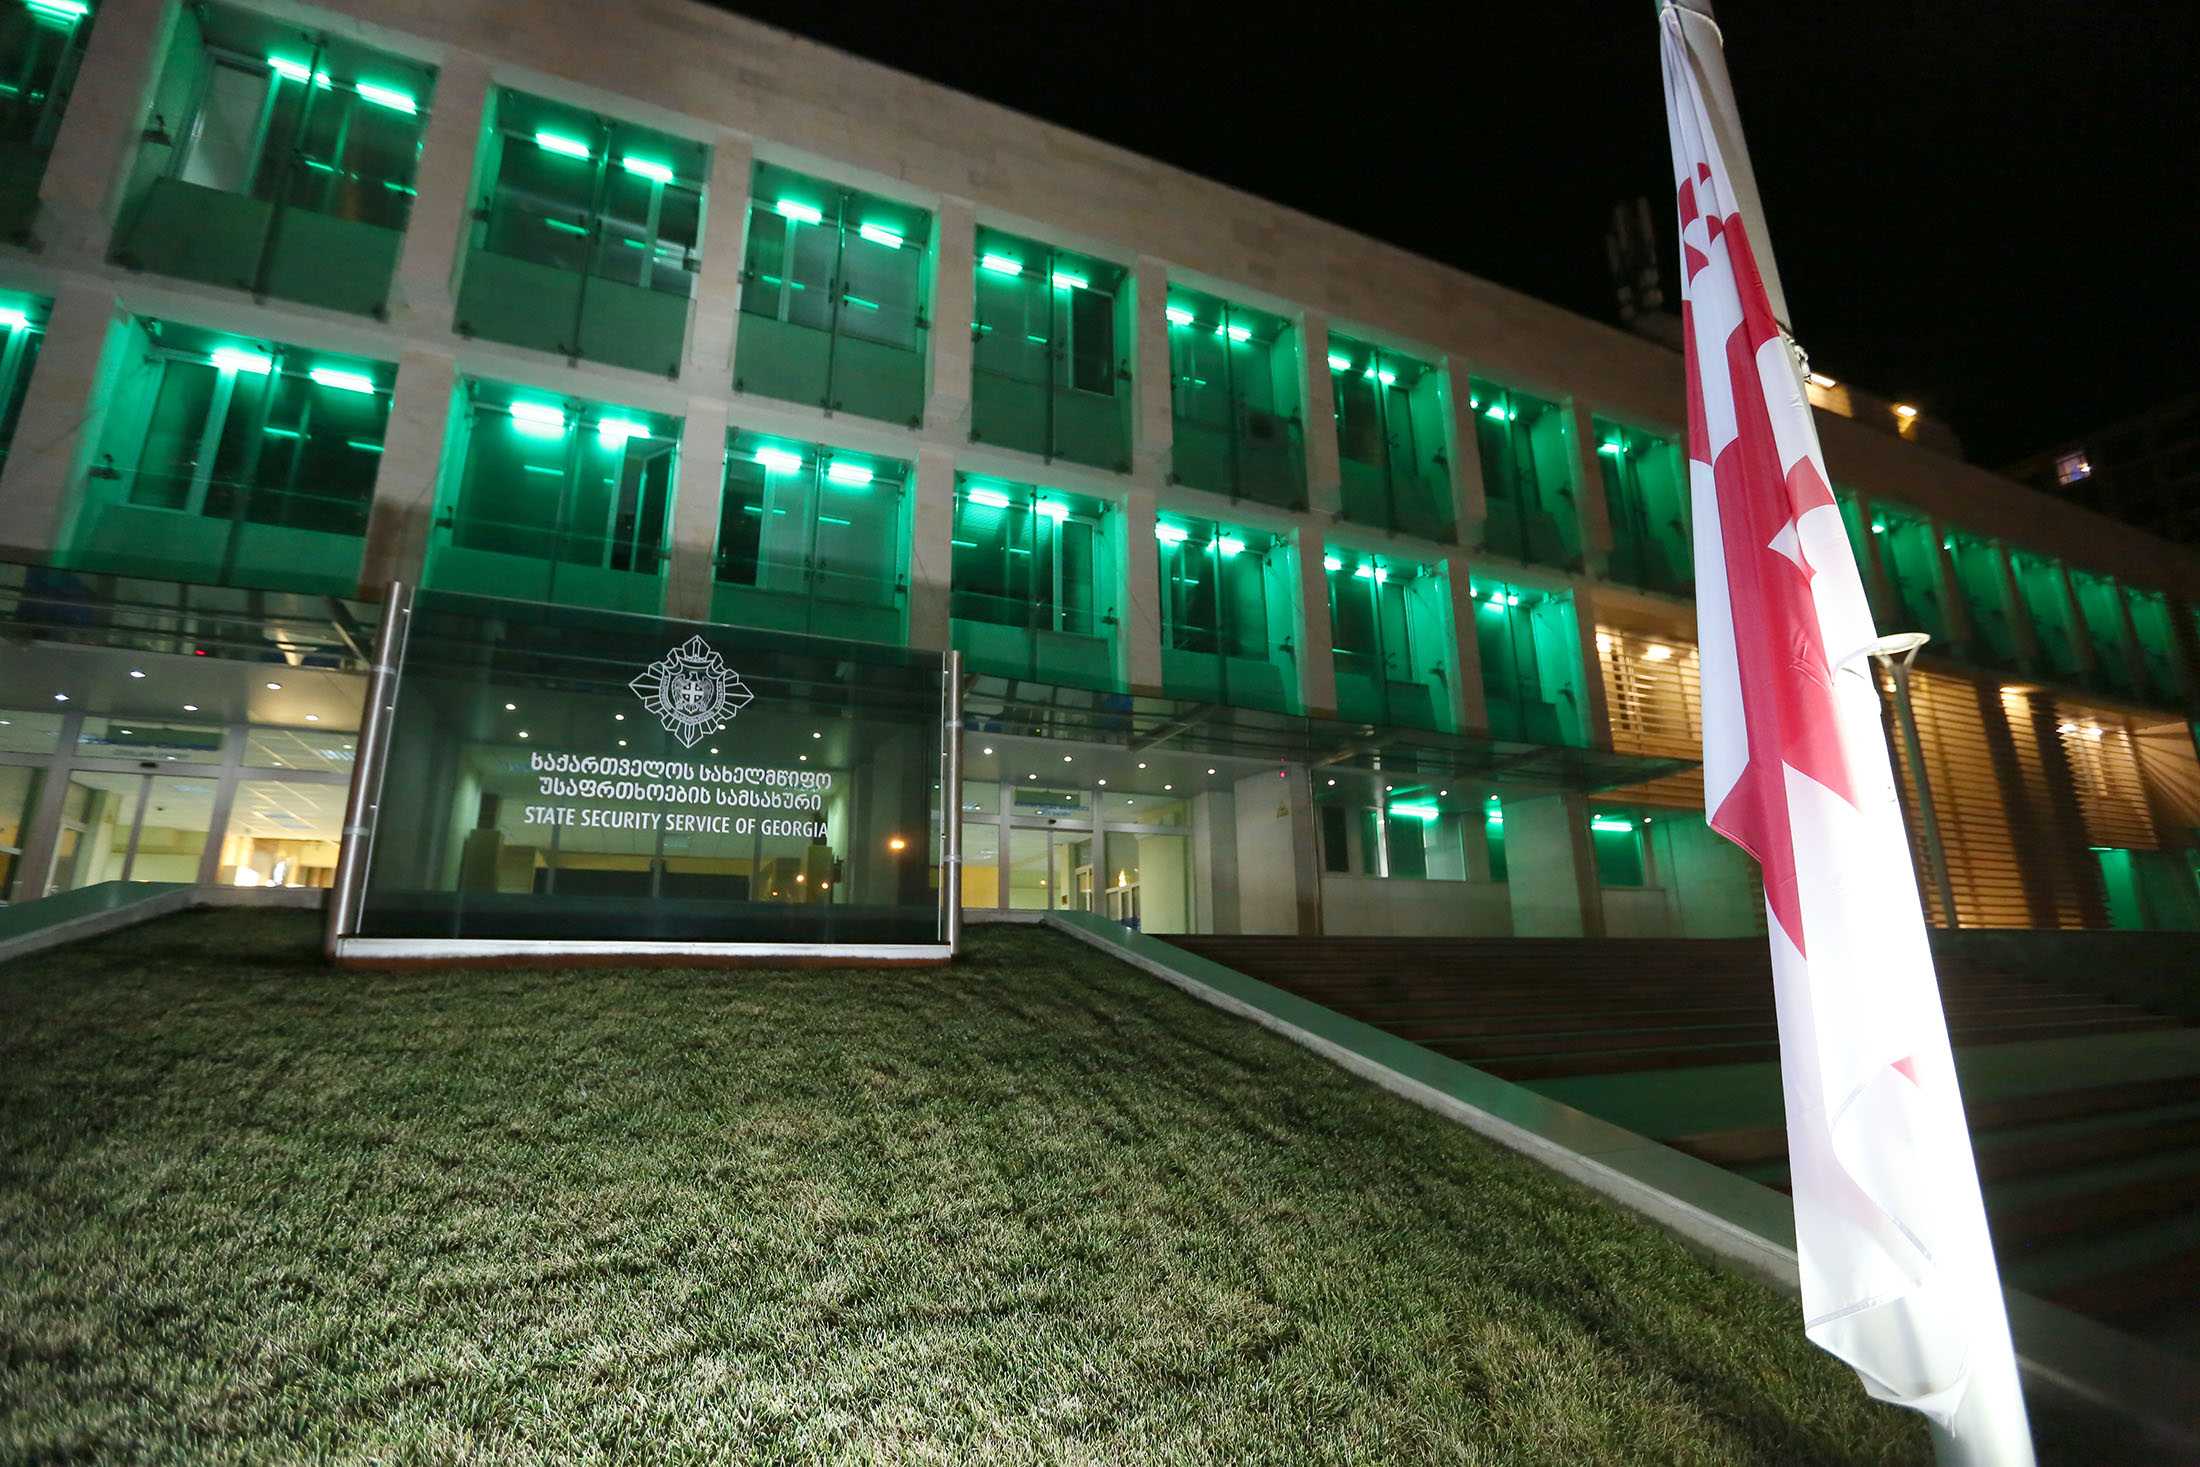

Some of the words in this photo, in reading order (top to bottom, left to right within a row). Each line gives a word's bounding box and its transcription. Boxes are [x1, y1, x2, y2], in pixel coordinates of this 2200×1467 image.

[530, 751, 695, 781] საქართველოს
[699, 763, 833, 790] სახელმწიფო
[538, 775, 712, 805] უსაფრთხოების
[716, 787, 823, 811] სამსახური
[523, 806, 577, 826] STATE
[580, 808, 662, 831] SECURITY
[665, 813, 731, 834] SERVICE
[735, 817, 757, 835] OF
[761, 818, 829, 839] GEORGIA
